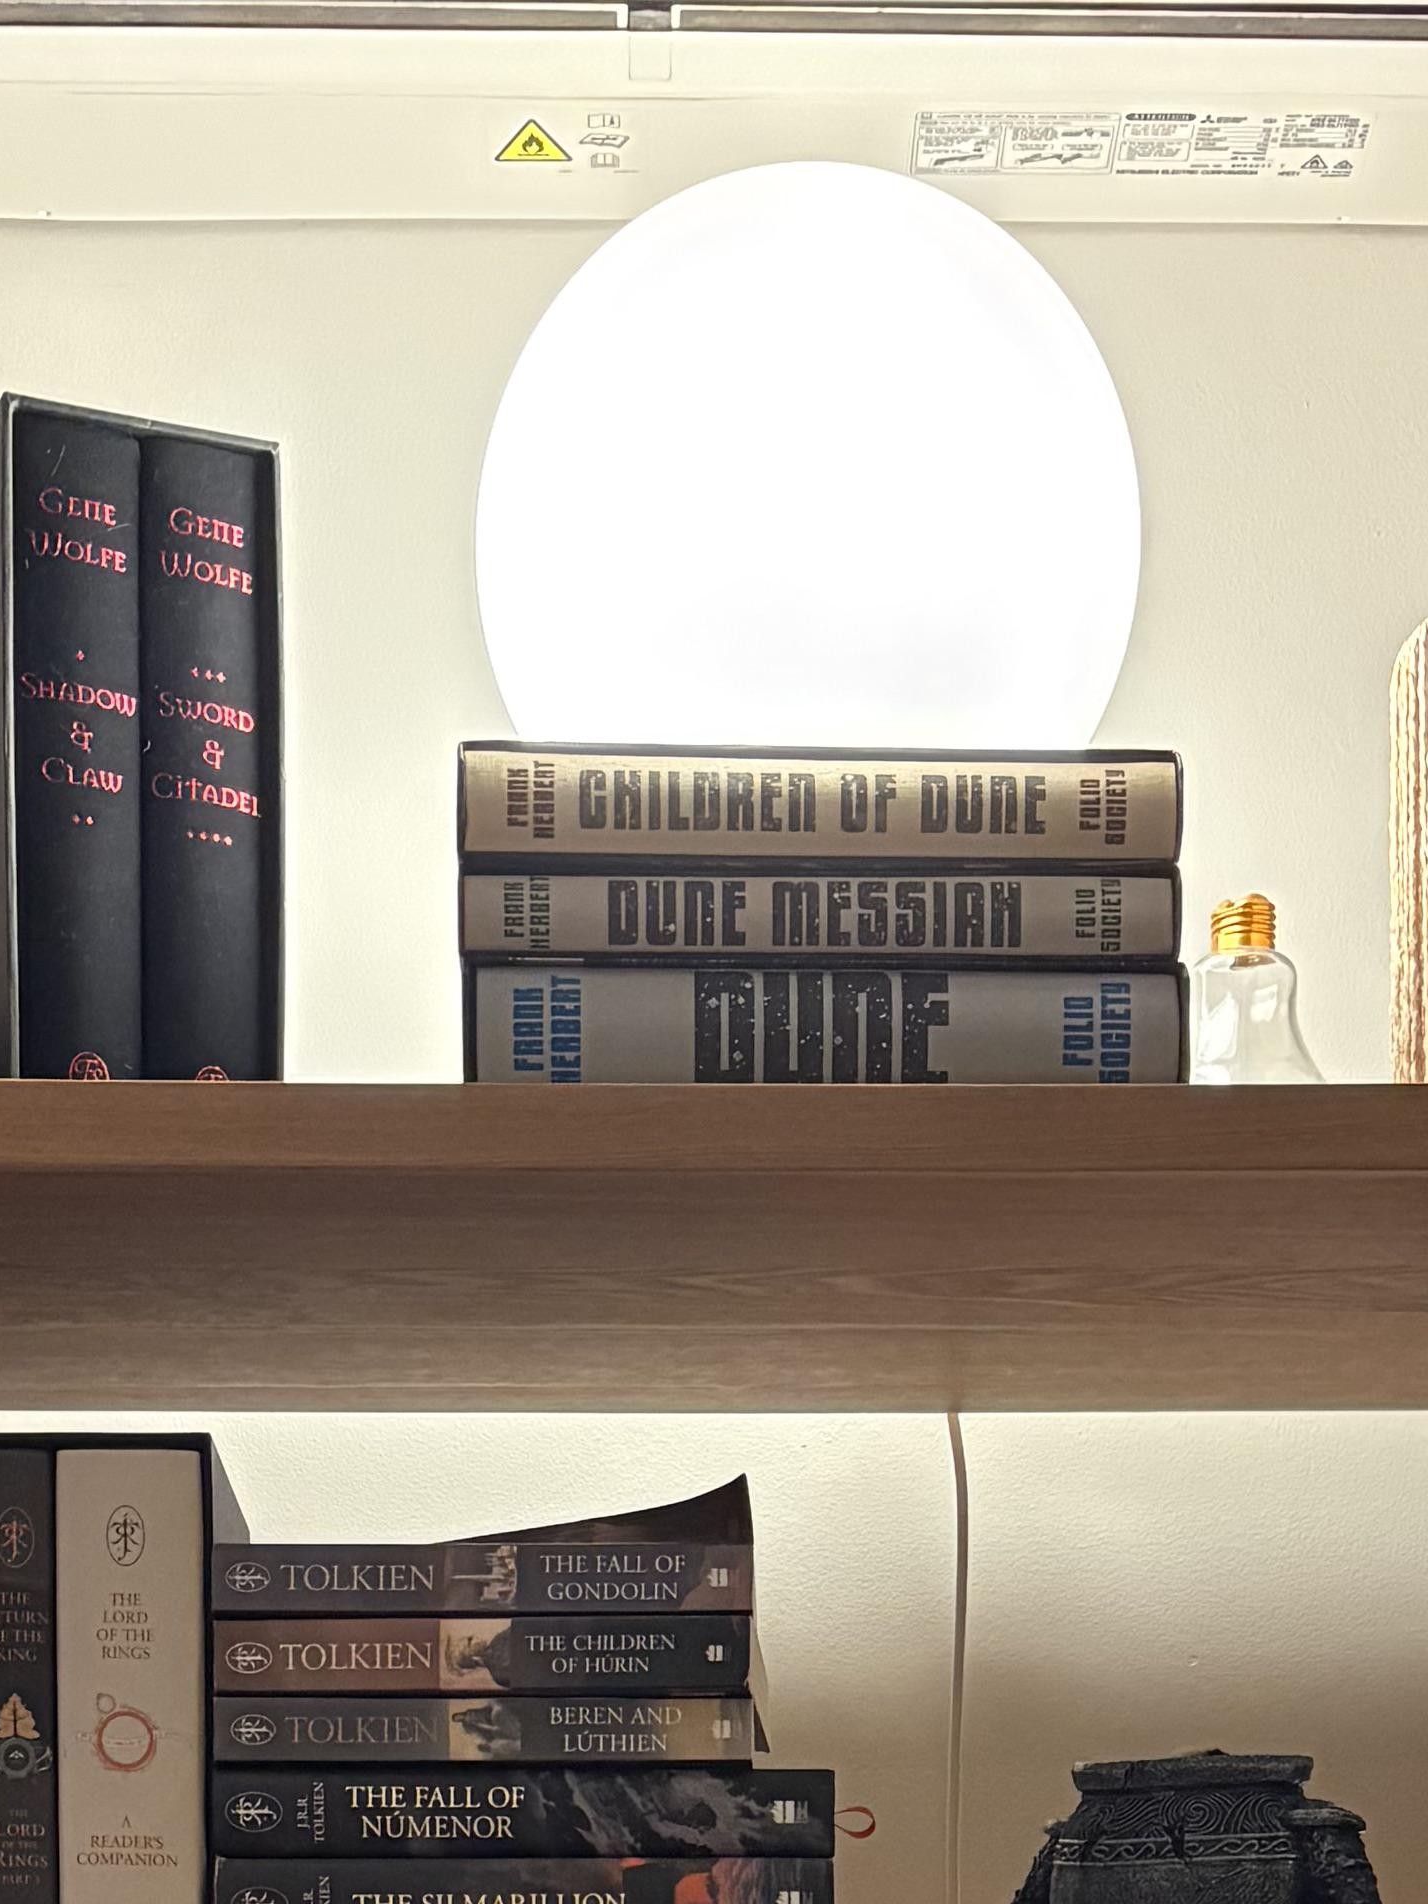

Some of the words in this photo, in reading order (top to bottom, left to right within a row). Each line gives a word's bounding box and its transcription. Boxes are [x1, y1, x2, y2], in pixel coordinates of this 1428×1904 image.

[28, 529, 127, 574] WOLFE
[160, 551, 253, 596] WOLFE
[21, 672, 137, 718] SHADOW
[158, 691, 255, 734] SWORD
[41, 757, 123, 795] CLAW
[579, 769, 817, 833] CHILDREN
[840, 773, 896, 834] OF
[921, 775, 1046, 835] DUNE
[1080, 778, 1100, 830] FOLIO
[1105, 769, 1127, 845] SOCIETY
[608, 880, 747, 946] DUNE
[773, 881, 1022, 947] MESSIAH
[694, 970, 949, 1083] DUNE
[281, 1564, 434, 1591] TOLKIEN
[540, 1555, 588, 1573] THE
[596, 1555, 647, 1573] FALL
[655, 1554, 685, 1573] OF
[110, 1592, 142, 1606] THE
[547, 1580, 678, 1601] GONDOLIN
[103, 1609, 149, 1625] LORD
[96, 1627, 116, 1642] OF
[121, 1628, 155, 1642] THE
[102, 1646, 151, 1660] RINGS
[280, 1643, 433, 1671] TOLKIEN
[346, 1785, 408, 1809] THE
[415, 1786, 480, 1809] FALL
[489, 1786, 525, 1808] OF
[362, 1810, 514, 1839] NÚMENOR
[90, 1834, 163, 1850] READER'S
[77, 1852, 178, 1867] COMPANION
